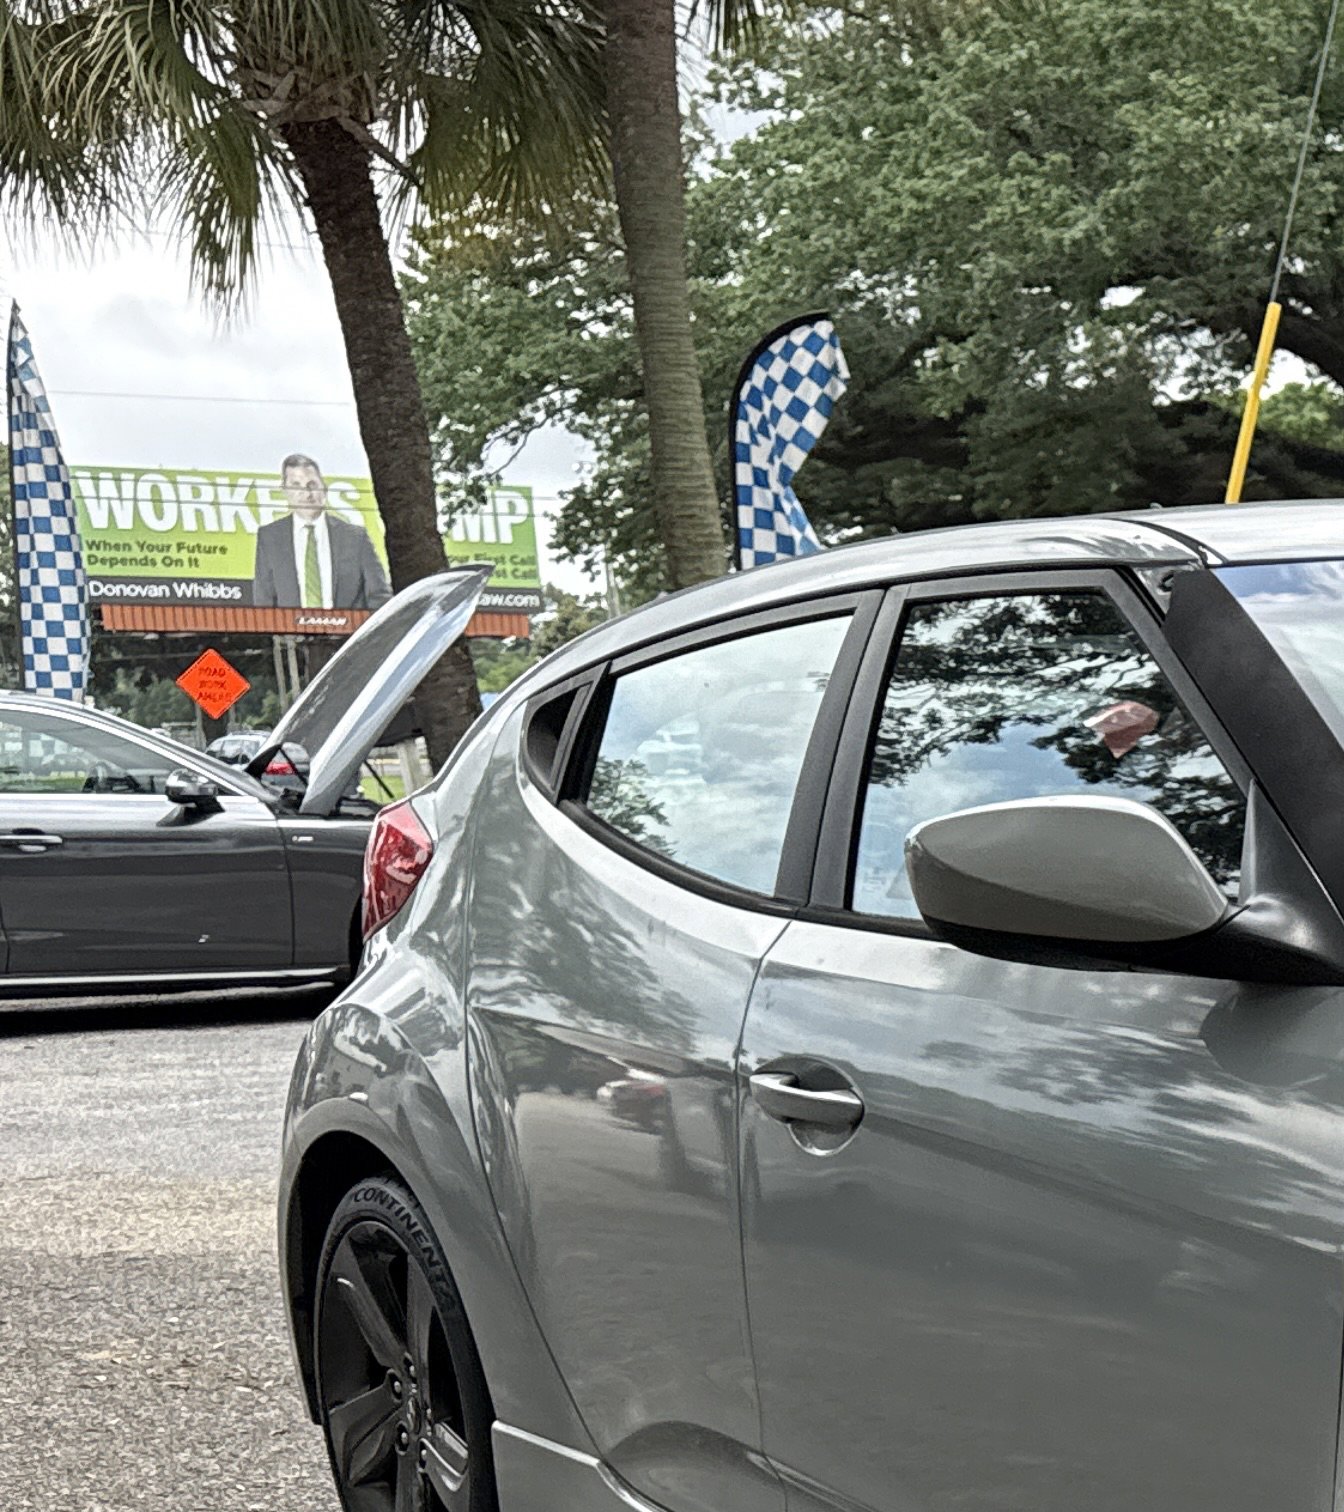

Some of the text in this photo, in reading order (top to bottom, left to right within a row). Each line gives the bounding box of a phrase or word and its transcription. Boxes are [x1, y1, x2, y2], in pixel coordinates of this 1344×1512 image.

[75, 471, 365, 534] WORKES
[86, 540, 228, 555] When Your Future
[87, 554, 199, 568] Depends On It
[89, 581, 242, 599] Donovan Whibbs
